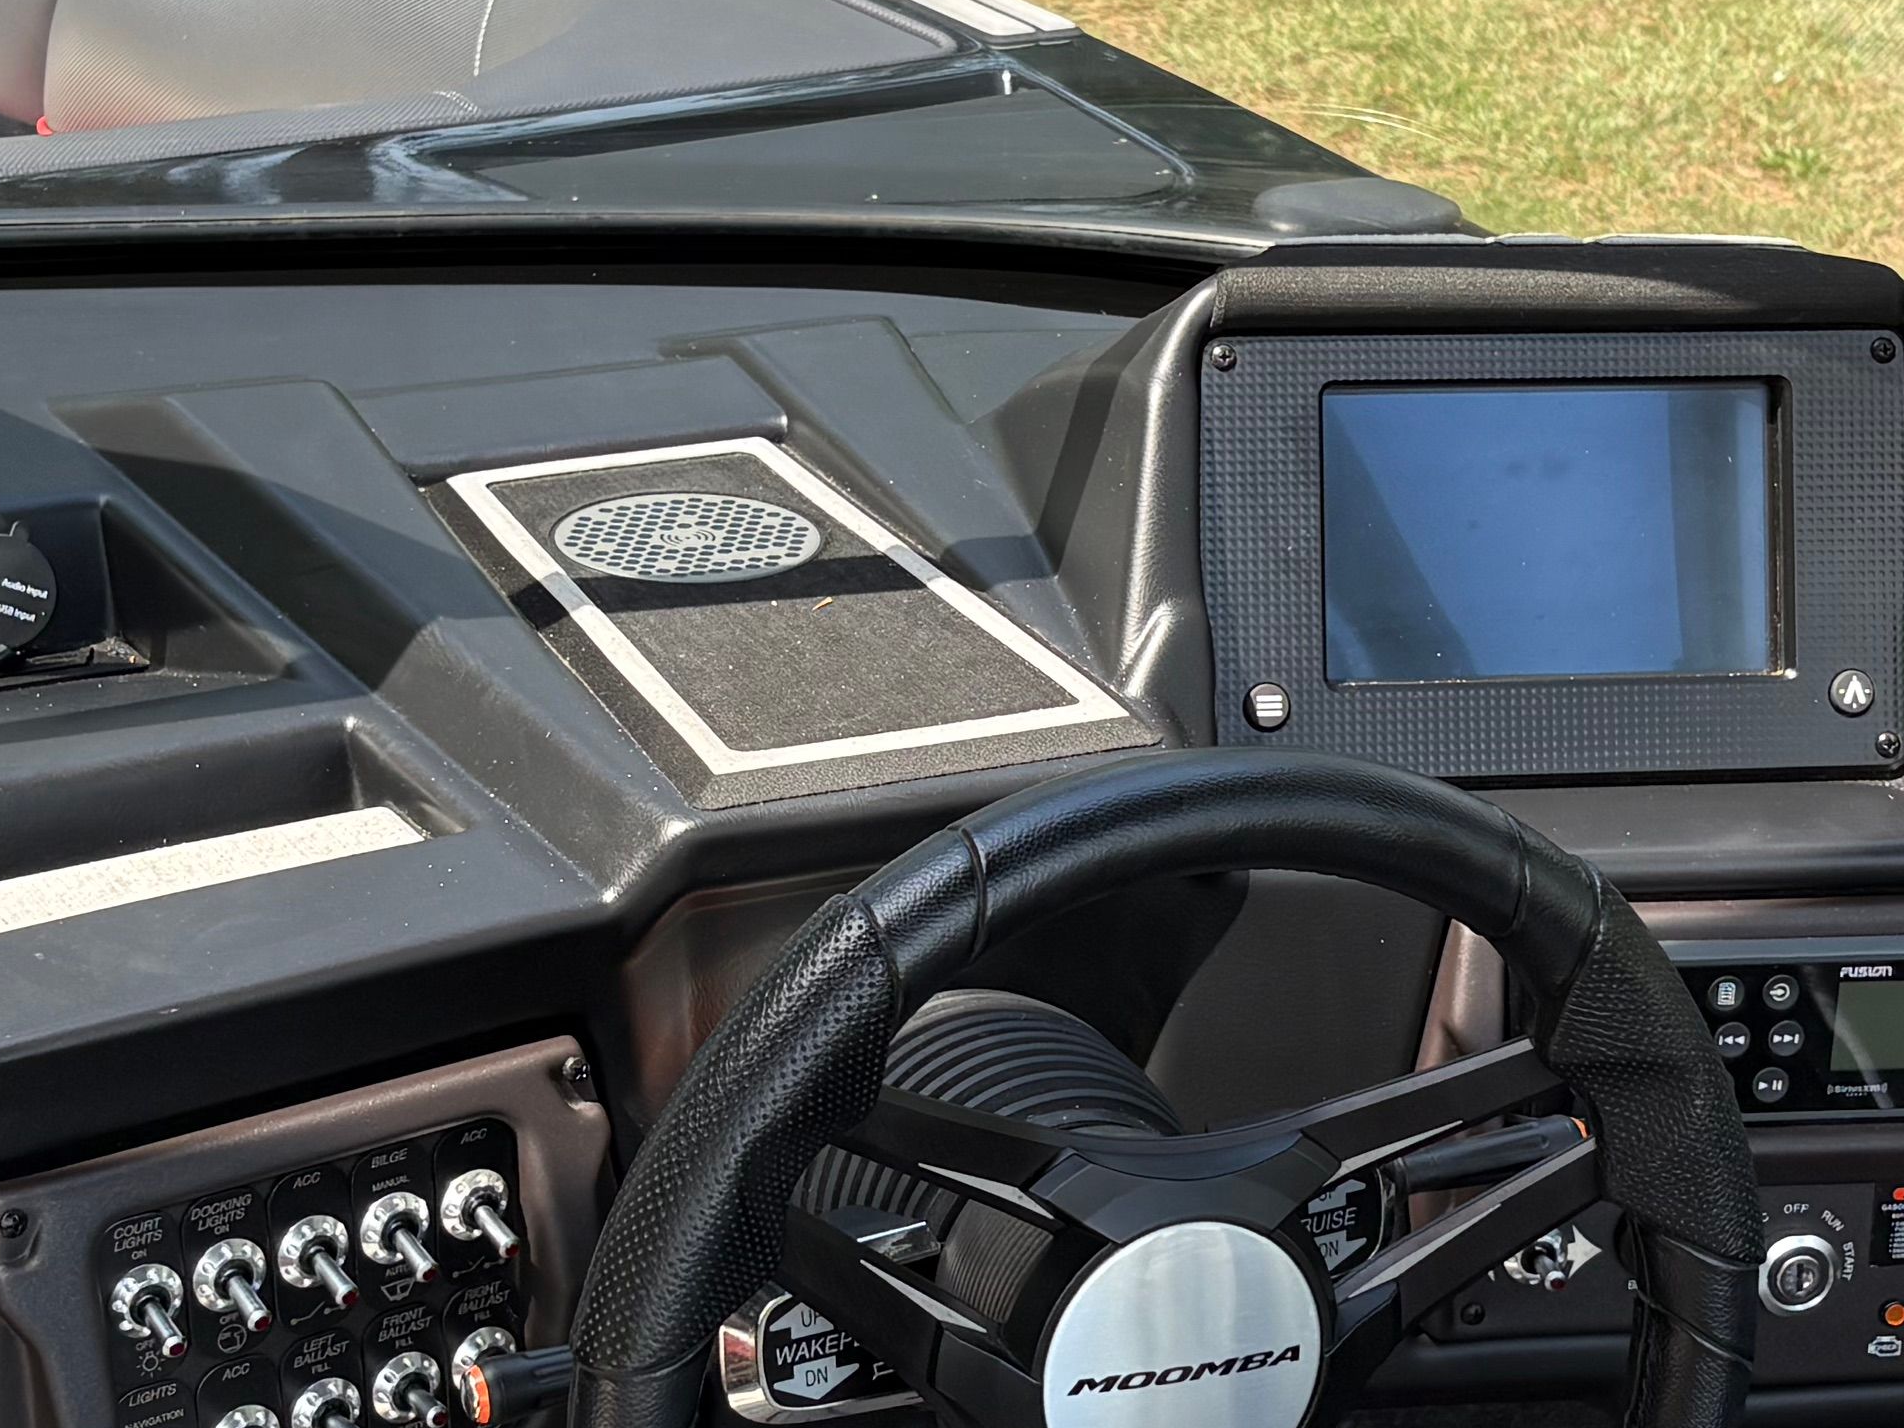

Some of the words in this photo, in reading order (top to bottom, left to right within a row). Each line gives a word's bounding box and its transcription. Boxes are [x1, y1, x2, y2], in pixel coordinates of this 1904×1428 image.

[1, 577, 26, 593] Audio
[26, 584, 49, 600] Input
[14, 608, 36, 623] Input
[1839, 965, 1893, 978] FUSION
[460, 1128, 488, 1146] ACC
[371, 1148, 408, 1169] BILGE
[293, 1172, 321, 1189] ACC
[372, 1175, 410, 1192] MANUAL
[191, 1193, 252, 1221] DOCKING
[1783, 1203, 1810, 1215] OFF
[114, 1217, 162, 1240] COURT
[198, 1207, 245, 1232] LIGHTS
[214, 1224, 230, 1236] ON
[1300, 1206, 1358, 1234] RUISE
[1821, 1210, 1845, 1232] RUN
[114, 1229, 163, 1253] LIGHTS
[131, 1248, 148, 1261] ON
[1842, 1241, 1855, 1281] START
[464, 1280, 502, 1301] RIGHT
[458, 1289, 511, 1315] BALLAST
[383, 1305, 427, 1329] FRONT
[378, 1315, 433, 1343] BALLAST
[303, 1332, 336, 1354] LEFT
[293, 1340, 350, 1369] BALLAST
[222, 1363, 251, 1382] ACC
[311, 1363, 332, 1375] FILL
[805, 1366, 829, 1387] DN
[1067, 1344, 1301, 1396] MOOMBA
[128, 1383, 177, 1407] LIGHTS
